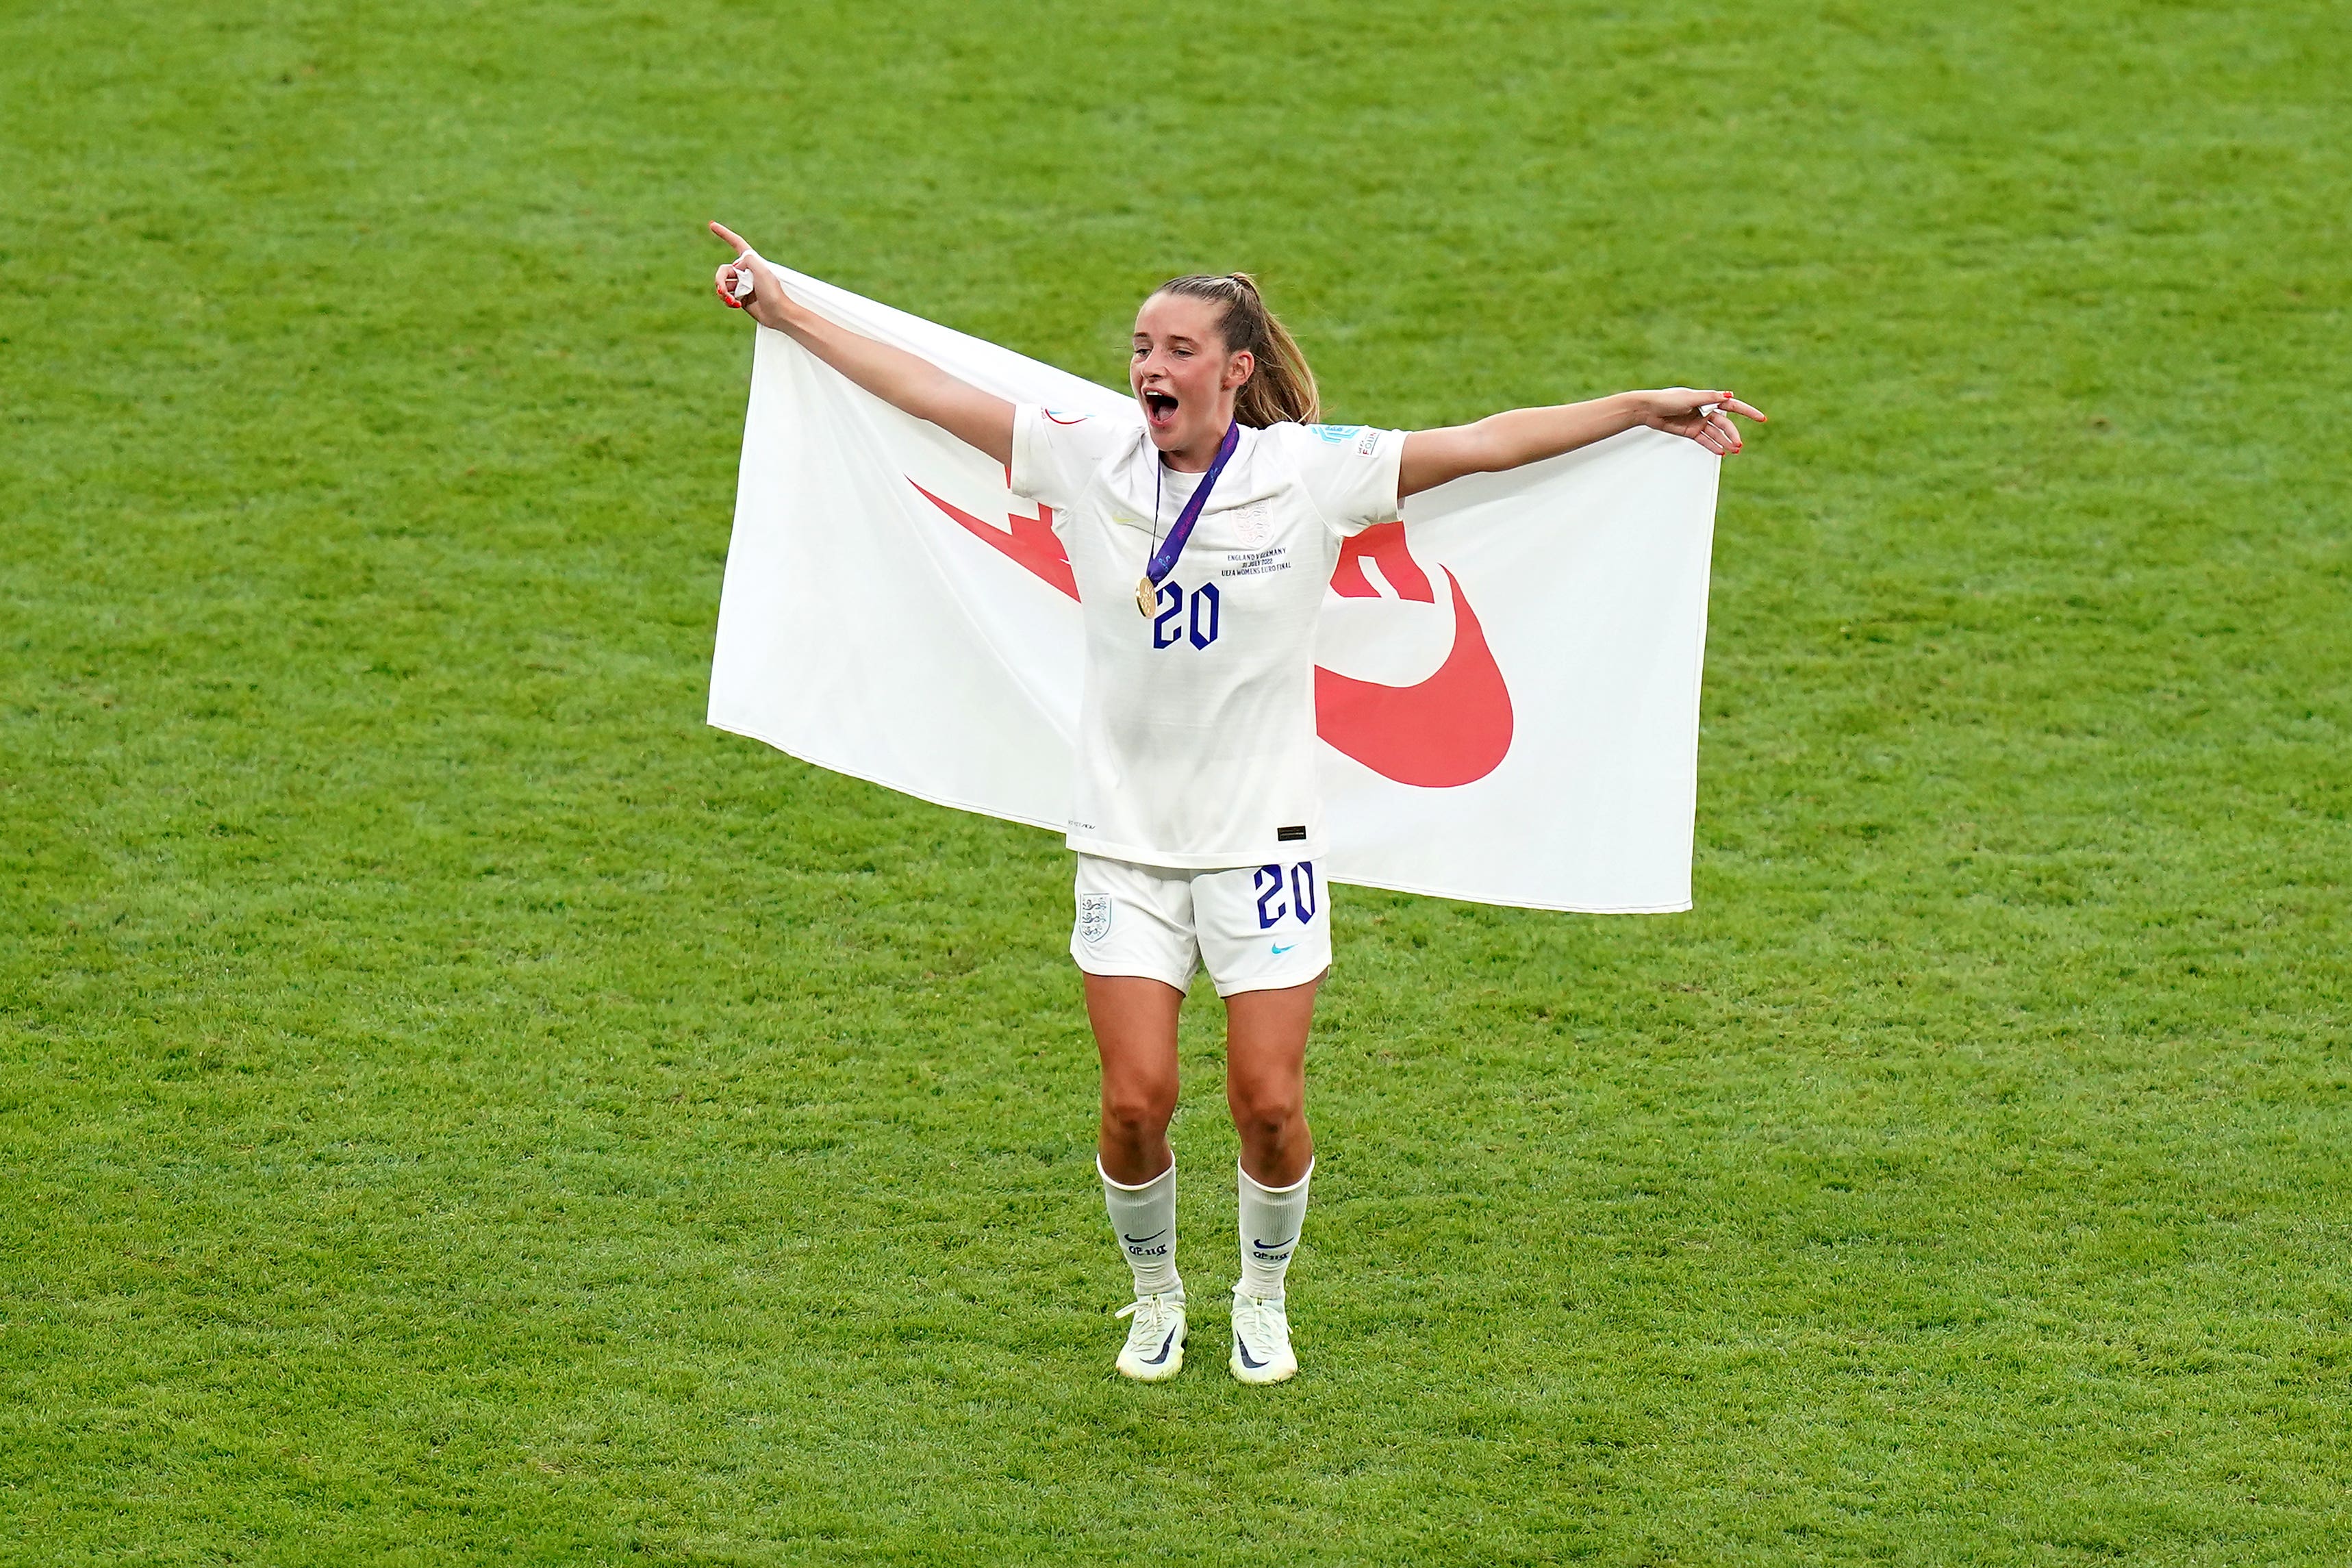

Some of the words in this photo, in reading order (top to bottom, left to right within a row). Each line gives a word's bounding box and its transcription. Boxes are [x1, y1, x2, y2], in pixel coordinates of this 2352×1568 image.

[1237, 567, 1261, 576] WOMENS
[1261, 565, 1276, 573] EURO
[1276, 562, 1291, 571] FINAL
[1260, 548, 1286, 559] GERMANY
[1154, 581, 1219, 650] 20
[1254, 861, 1315, 929] 20
